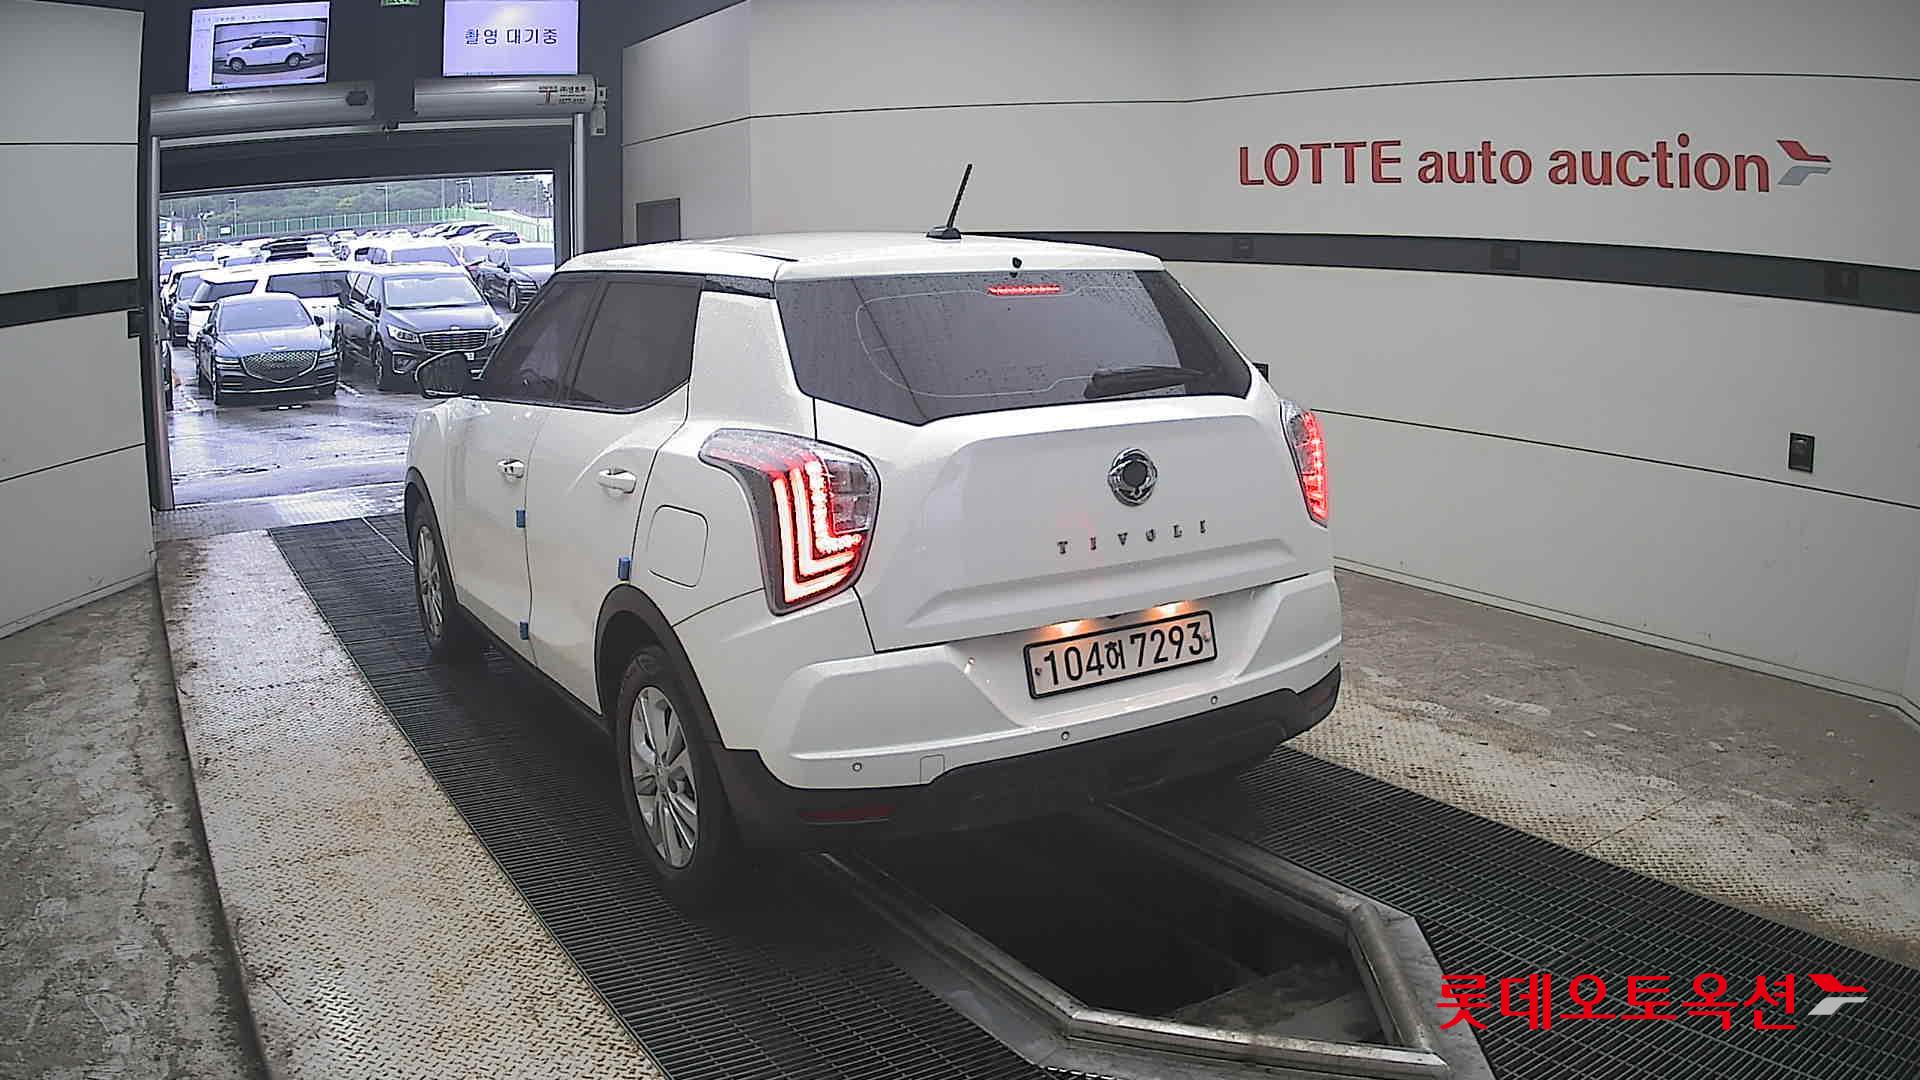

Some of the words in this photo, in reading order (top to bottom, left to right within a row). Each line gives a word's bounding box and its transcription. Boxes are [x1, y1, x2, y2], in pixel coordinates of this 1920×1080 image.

[506, 28, 558, 45] 대기중
[1239, 140, 1401, 187] LOTTE
[1417, 140, 1532, 186] auto
[1548, 133, 1770, 193] auction
[1056, 519, 1206, 555] TIVOLI
